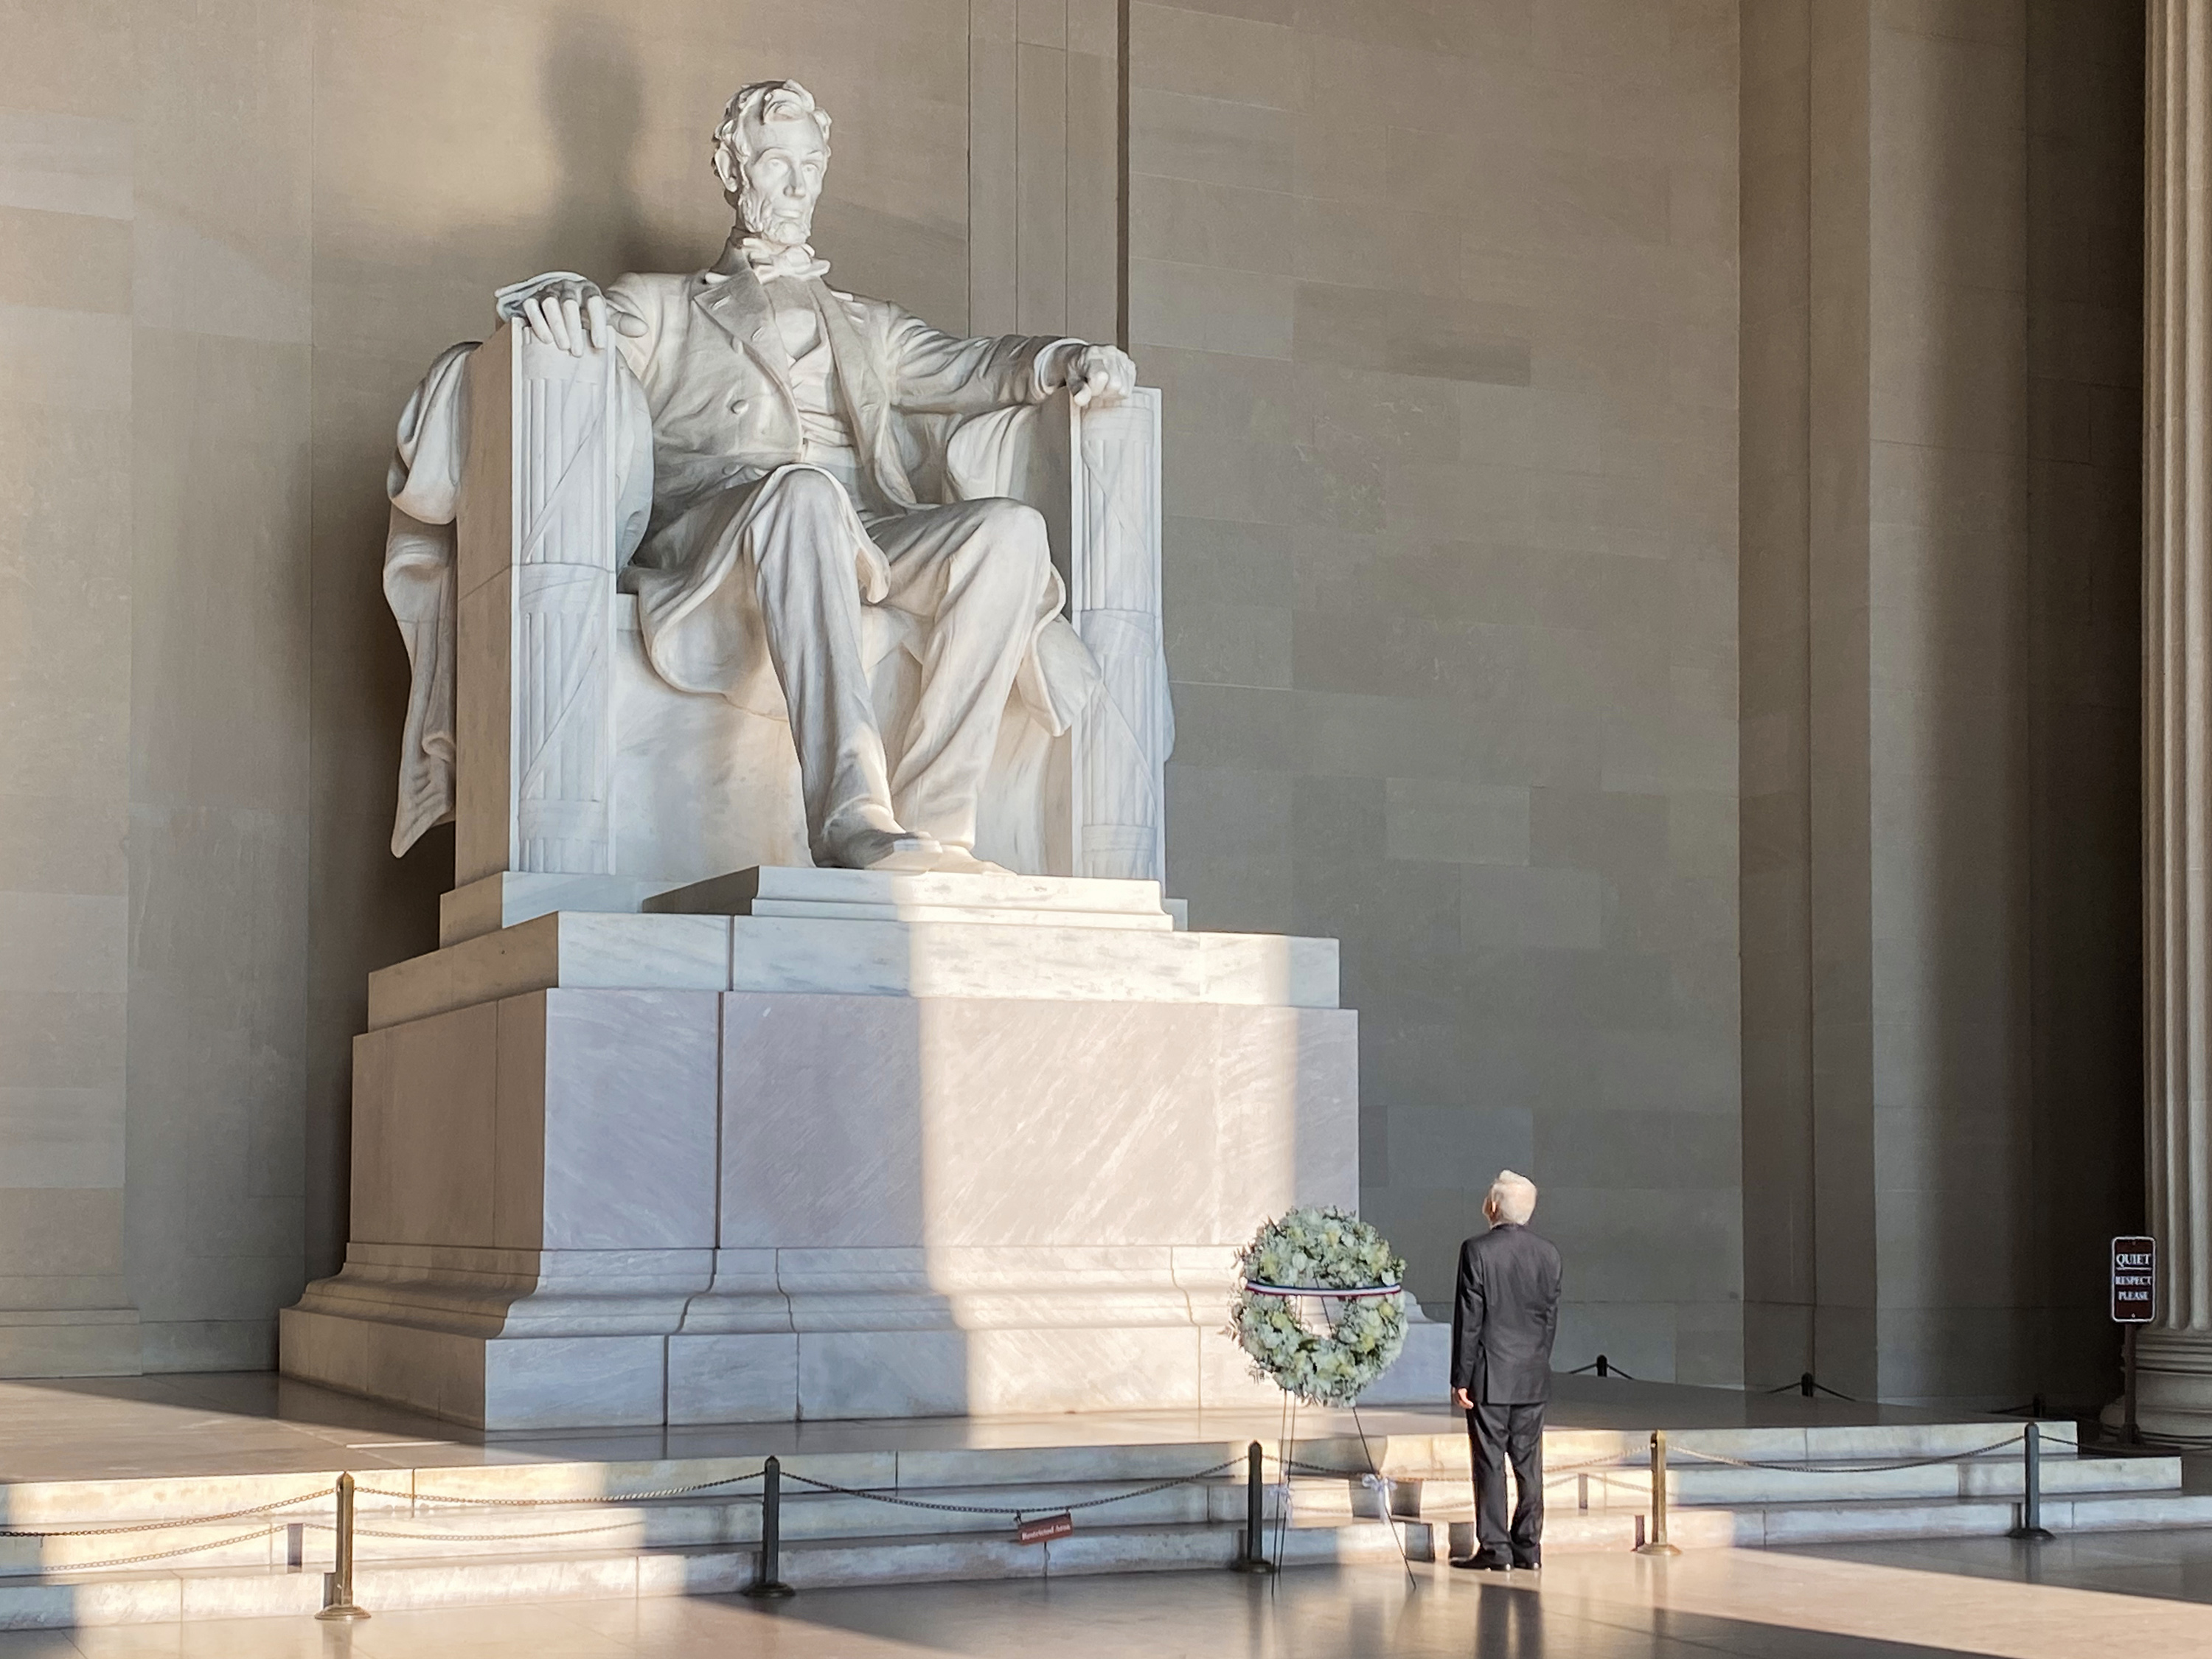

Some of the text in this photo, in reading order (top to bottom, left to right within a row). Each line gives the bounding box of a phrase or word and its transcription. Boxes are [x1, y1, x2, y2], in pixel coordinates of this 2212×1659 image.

[2116, 1253, 2151, 1267] QUIET
[2115, 1276, 2152, 1285] RESPECT
[2118, 1291, 2149, 1301] PLEASE
[1021, 1524, 1071, 1540] Restricted Area
